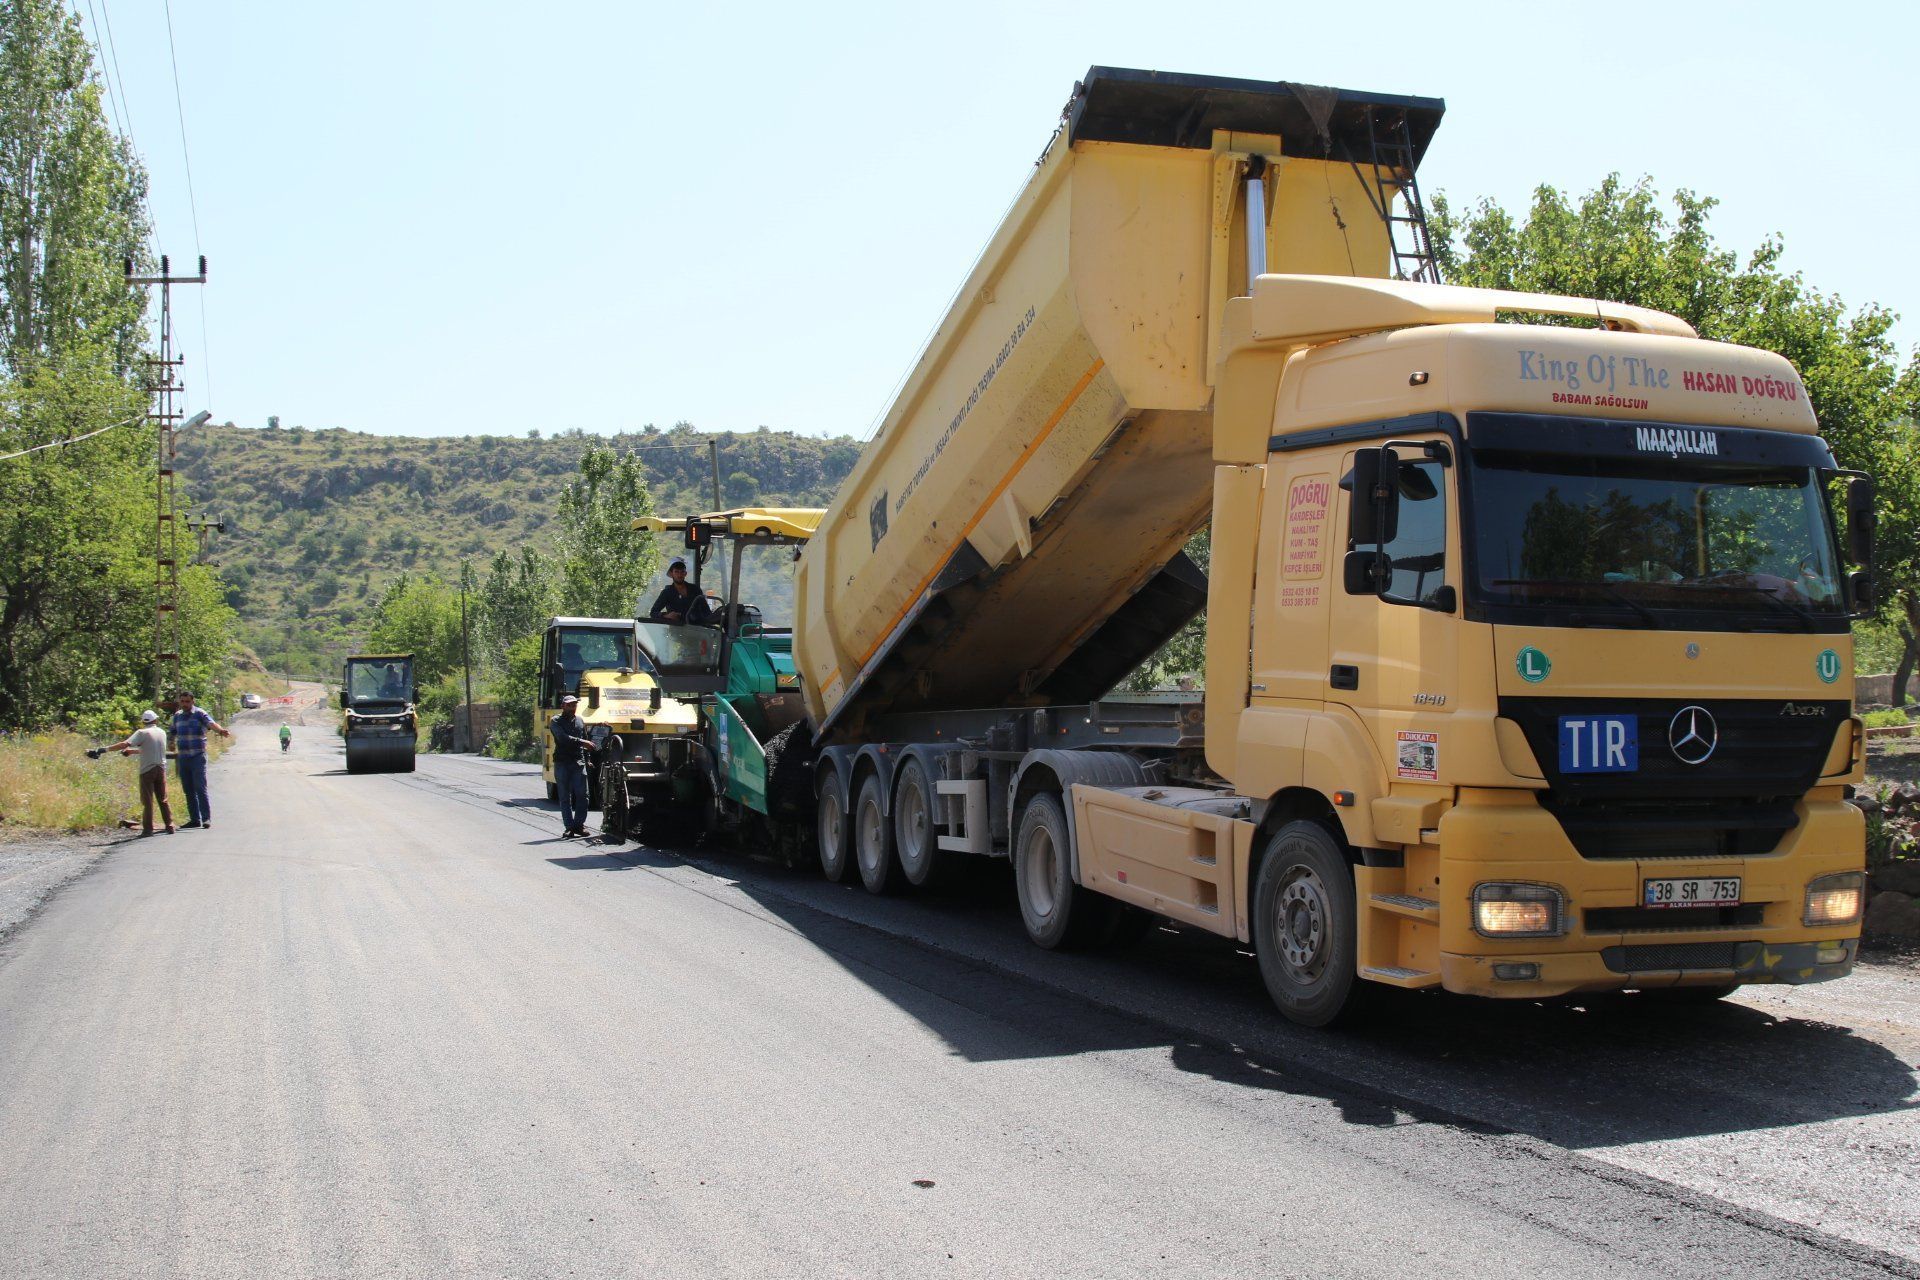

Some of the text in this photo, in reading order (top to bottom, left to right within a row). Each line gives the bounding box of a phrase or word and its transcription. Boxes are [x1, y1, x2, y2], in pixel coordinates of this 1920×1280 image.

[1025, 304, 1036, 328] 334
[1518, 350, 1670, 392] King Of The
[1683, 371, 1796, 401] HASAN DOĞRU
[1552, 393, 1649, 410] BABAM SAĞOLSUN
[1636, 427, 1718, 459] MAAŞALLAH
[1290, 479, 1330, 511] DOĞRU
[1526, 652, 1542, 675] L
[1822, 655, 1836, 678] U
[1565, 720, 1627, 768] TIR
[1656, 881, 1738, 901] 38 SR 753
